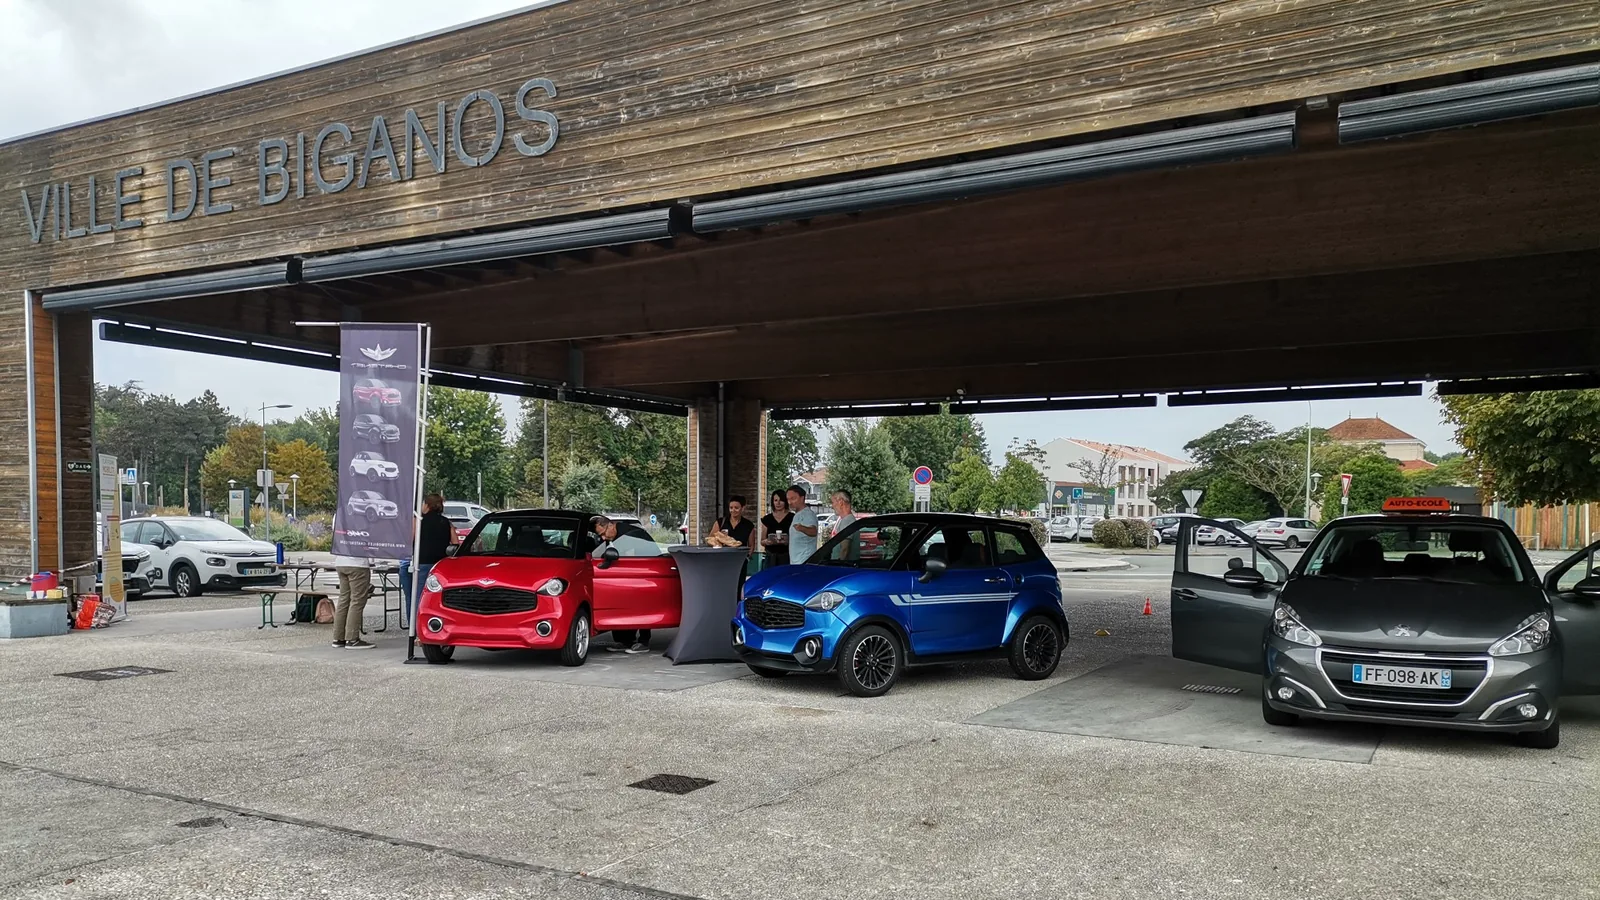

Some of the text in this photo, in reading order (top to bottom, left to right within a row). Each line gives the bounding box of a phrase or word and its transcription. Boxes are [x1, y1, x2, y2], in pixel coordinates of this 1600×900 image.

[21, 77, 560, 243] VILLE DE BIGANOS
[1365, 667, 1439, 686] FF-098-AK
